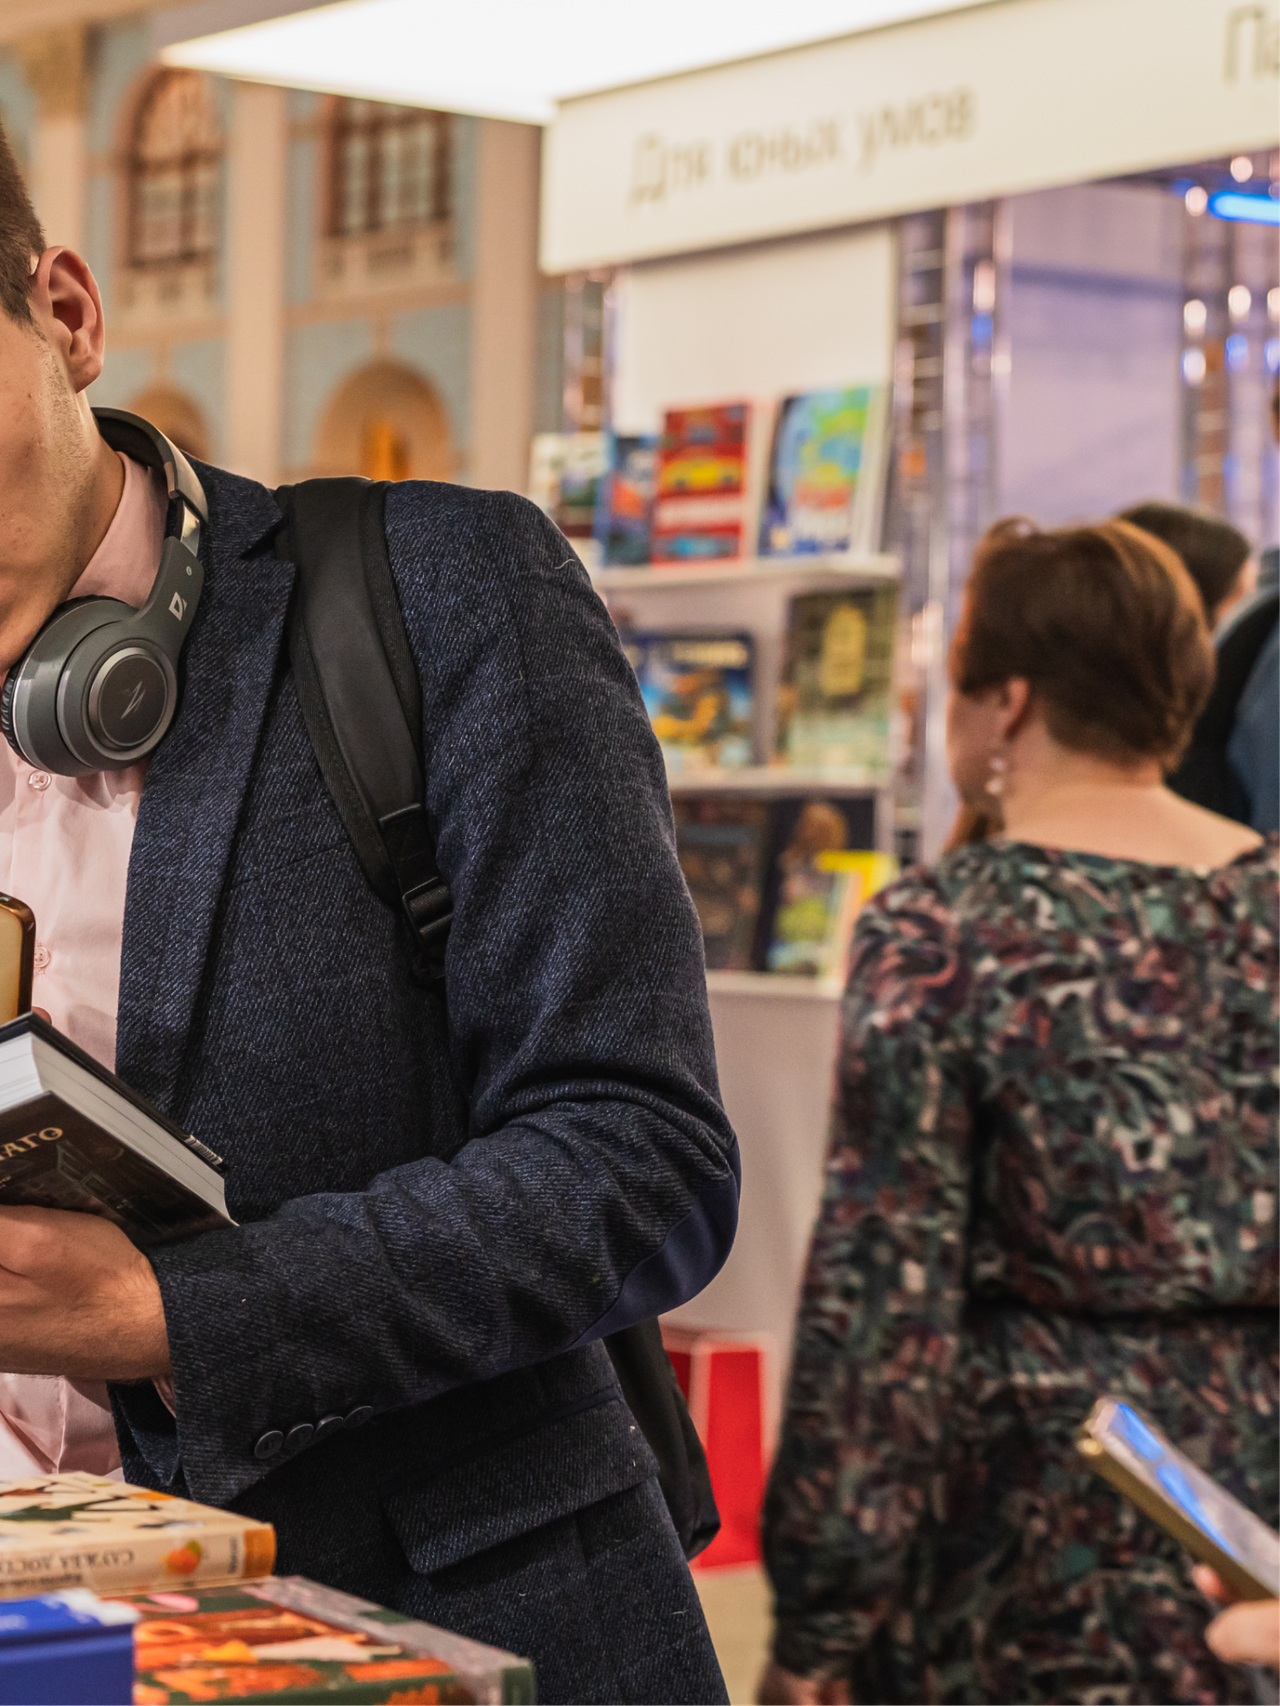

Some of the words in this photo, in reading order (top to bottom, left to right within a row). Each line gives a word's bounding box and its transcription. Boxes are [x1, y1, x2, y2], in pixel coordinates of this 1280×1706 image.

[625, 130, 710, 210] Для
[727, 117, 840, 183] юных
[857, 85, 978, 178] умов
